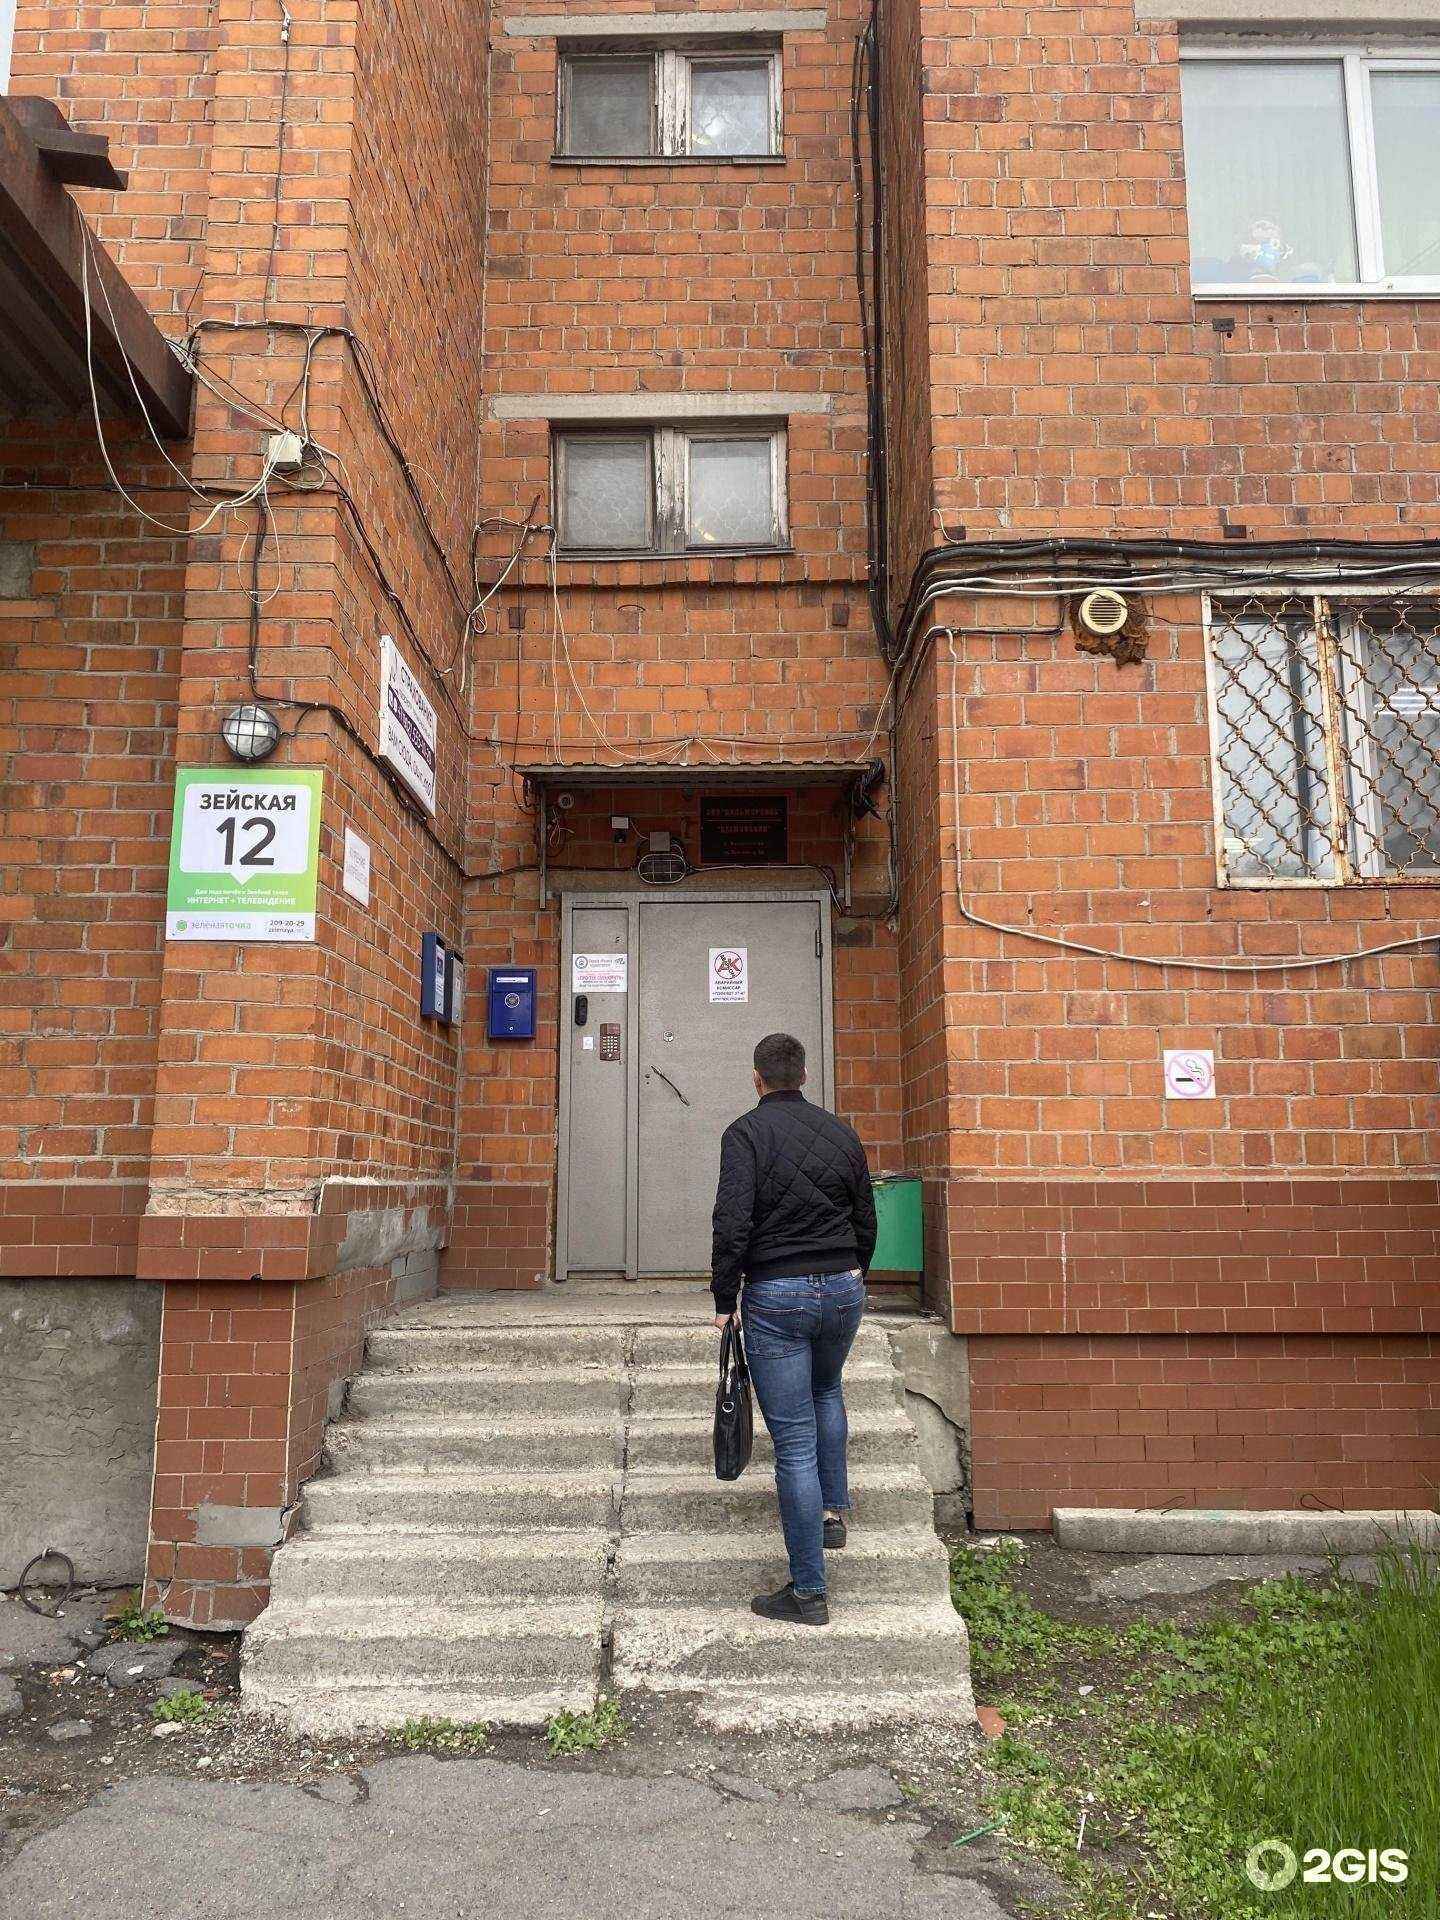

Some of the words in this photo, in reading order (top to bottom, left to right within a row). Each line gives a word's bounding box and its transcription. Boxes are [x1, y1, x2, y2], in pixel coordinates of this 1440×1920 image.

[200, 789, 296, 811] ЗЕЙСКАЯ
[216, 816, 276, 866] 12
[186, 896, 230, 905] ИНТЕРНЕТ
[237, 896, 296, 907] ТЕЛЕВИДЕНИЕ
